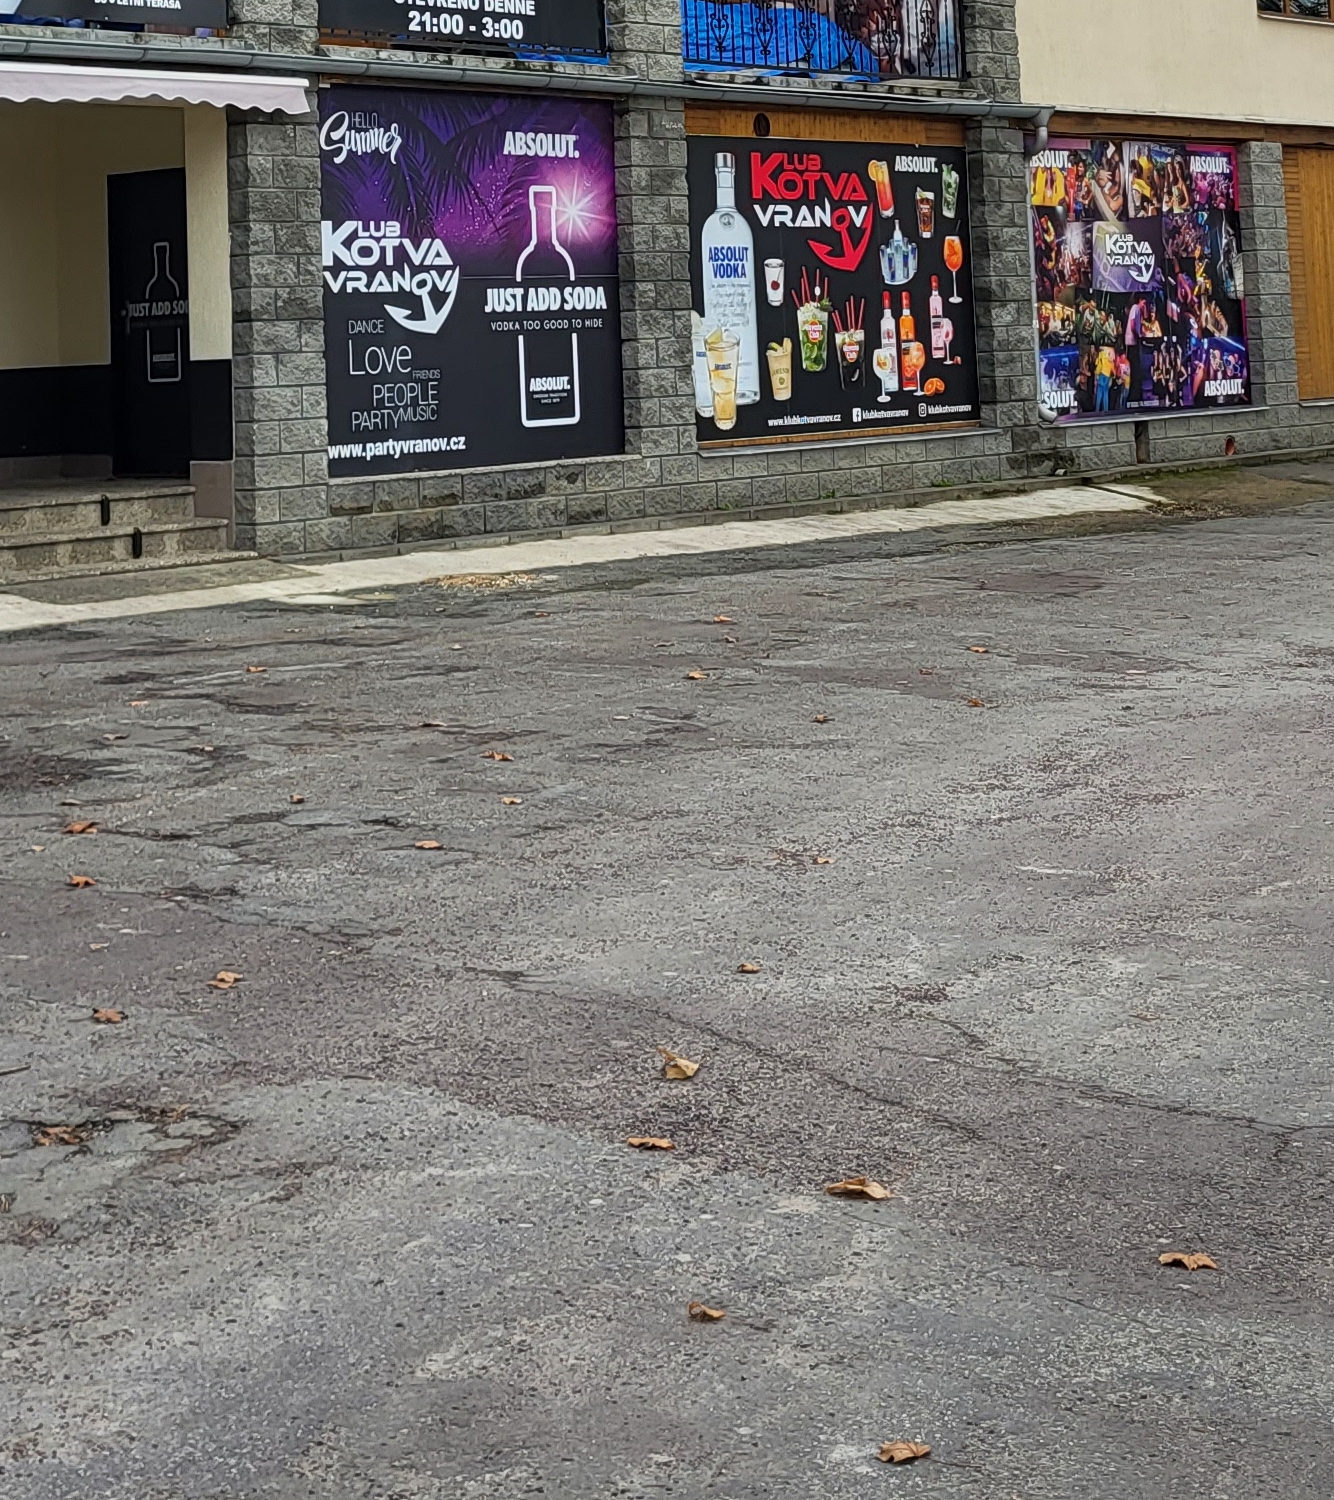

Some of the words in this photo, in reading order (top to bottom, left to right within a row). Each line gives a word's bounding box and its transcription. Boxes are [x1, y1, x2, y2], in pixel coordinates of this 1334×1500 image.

[408, 11, 464, 36] 21:00
[482, 17, 523, 40] 3:00
[351, 112, 378, 128] HELLO
[319, 110, 402, 164] Summer
[750, 152, 867, 200] KOTVA
[752, 197, 867, 232] VRANOV
[321, 220, 453, 266] KOTVA
[708, 246, 749, 263] ABSOLUT
[712, 263, 747, 279] VODKA
[151, 301, 171, 316] ADD
[484, 288, 524, 313] JUST
[526, 287, 561, 311] ADD
[563, 286, 607, 311] SODA
[348, 319, 385, 334] DANCE
[491, 321, 520, 331] VODKA
[523, 320, 541, 330] TOO
[543, 319, 568, 329] GOOD
[571, 318, 582, 328] TO
[584, 318, 603, 328] HIDE
[348, 339, 412, 375] Love
[412, 369, 441, 380] FRIENDS
[373, 381, 439, 407] PEOPLE
[351, 408, 401, 432] PARTY
[400, 405, 438, 422] MUSIC
[327, 436, 466, 461] www.partyvranov.cz
